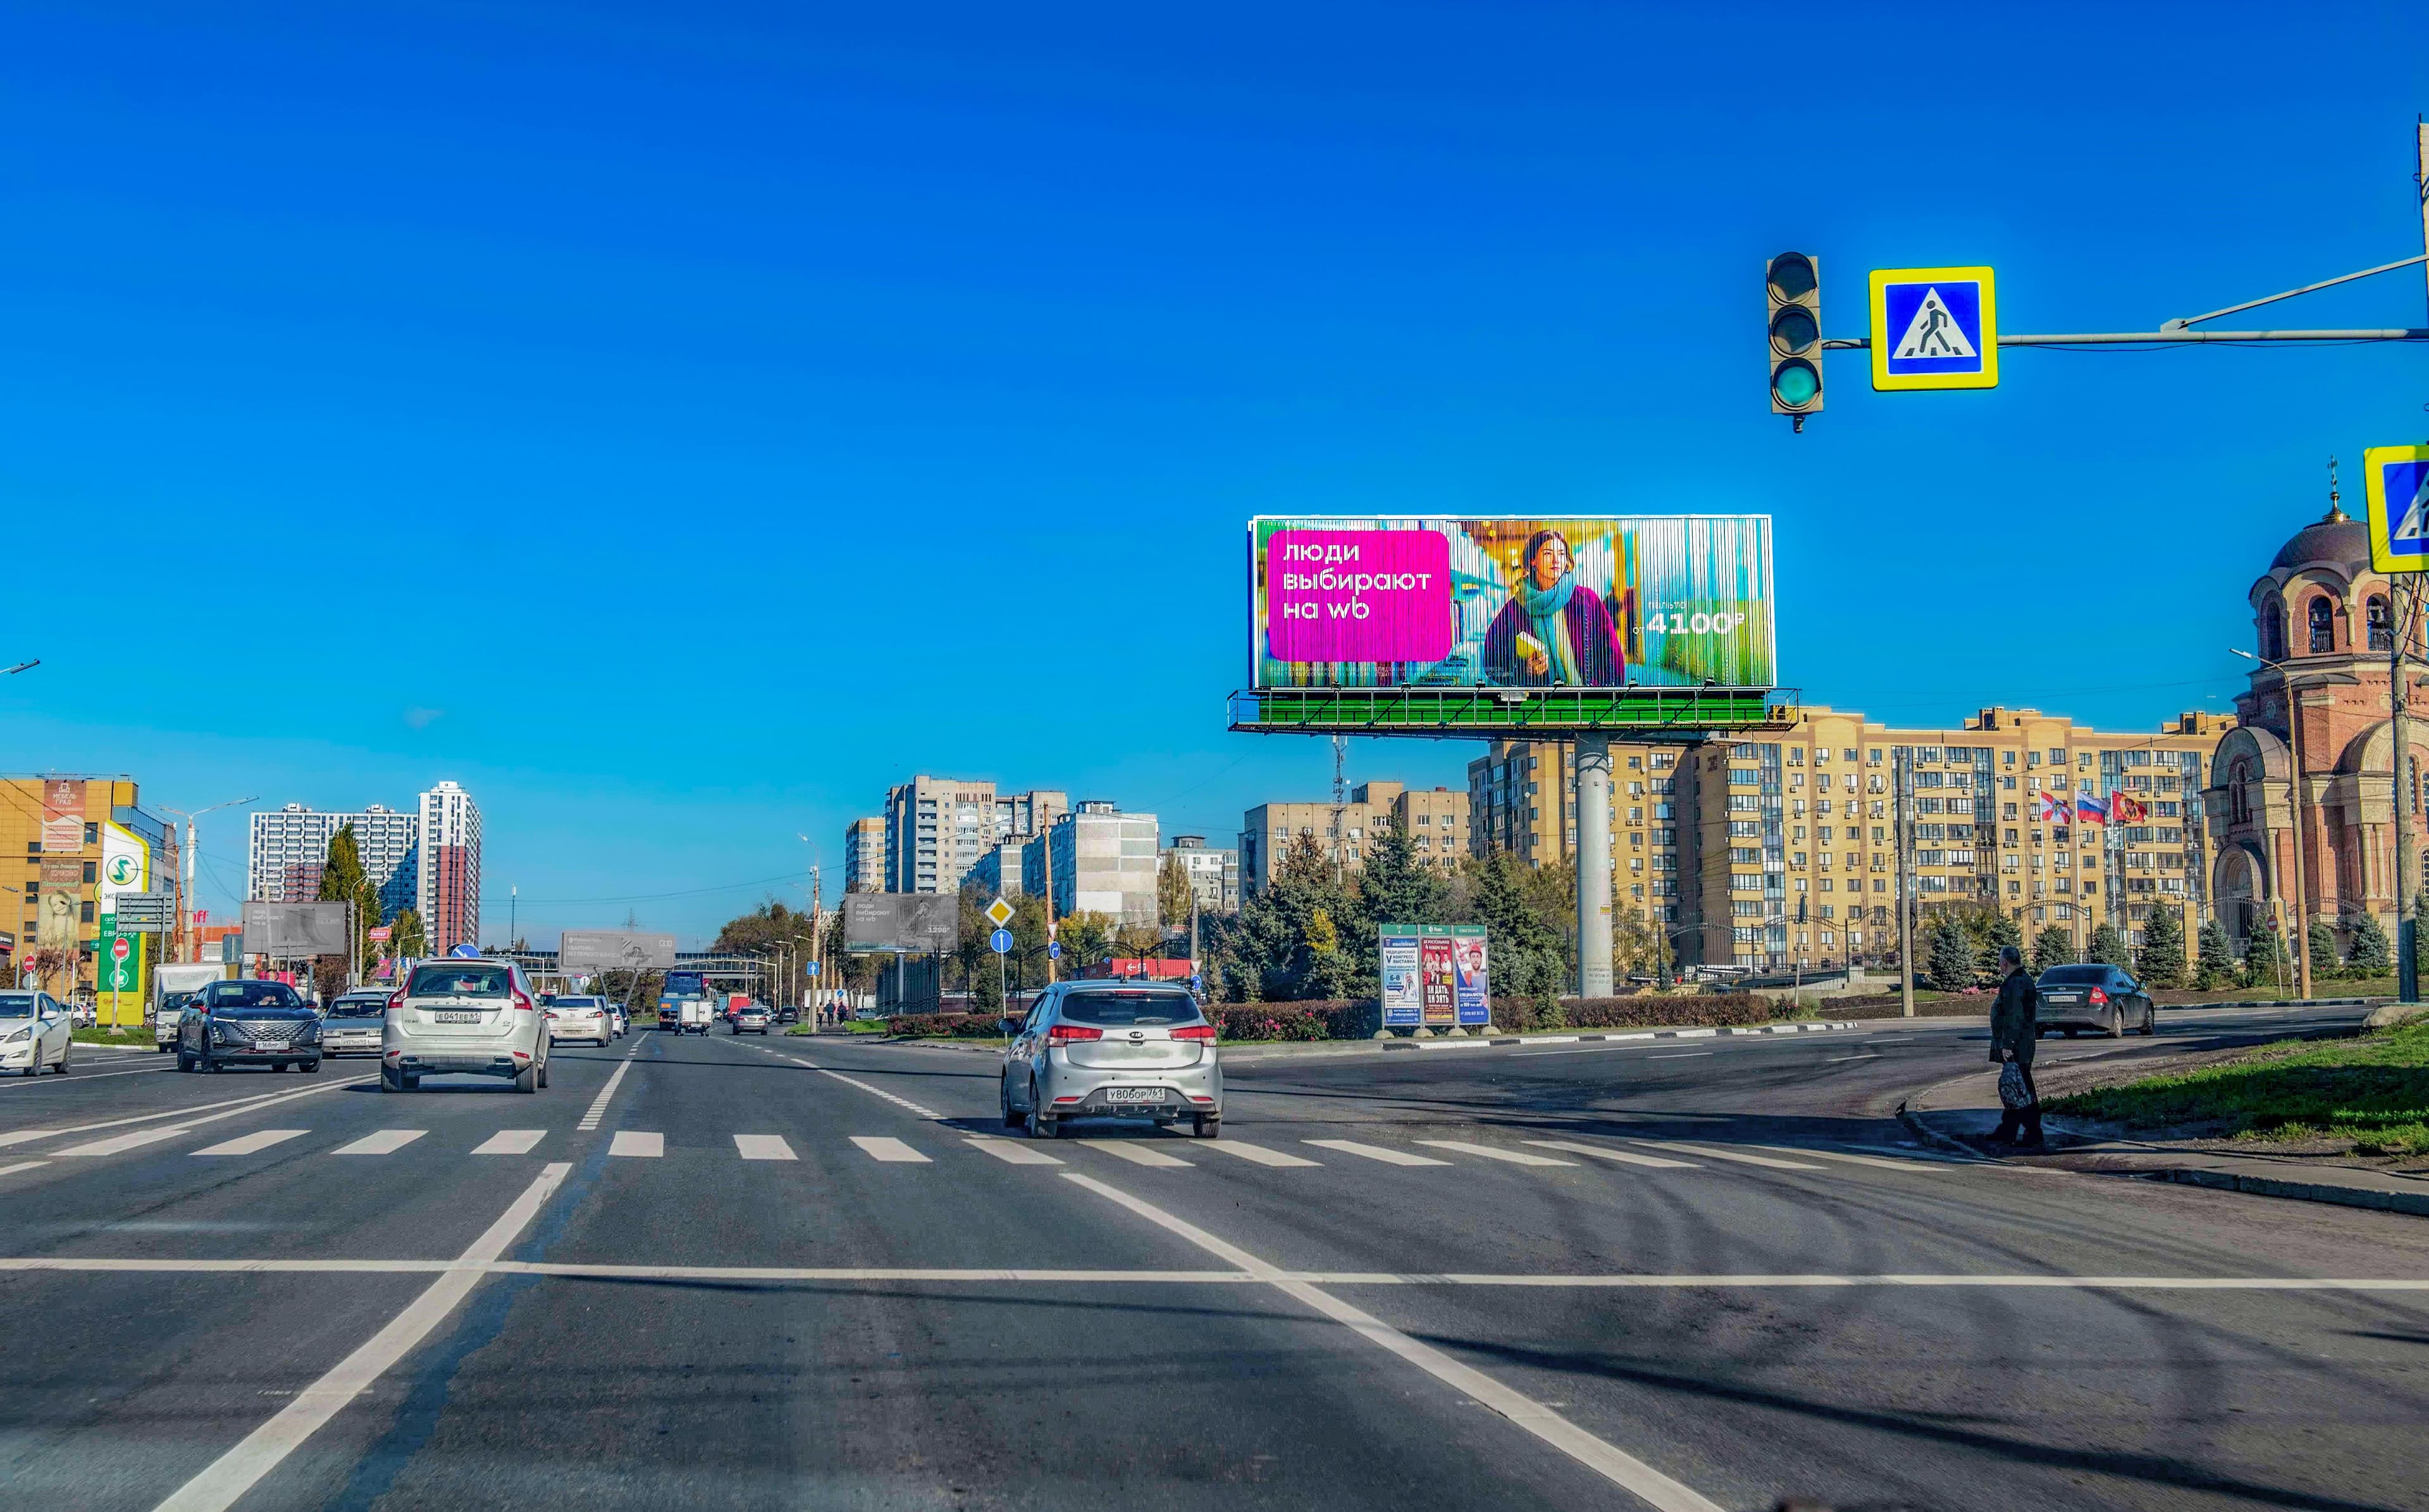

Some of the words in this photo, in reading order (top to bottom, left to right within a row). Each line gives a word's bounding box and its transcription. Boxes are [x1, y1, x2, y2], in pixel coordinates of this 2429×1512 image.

[1283, 544, 1359, 565] люди
[1283, 567, 1431, 596] выбирают
[1283, 602, 1318, 619] на
[1326, 596, 1369, 620] wb
[1427, 985, 1434, 993] НИ
[1428, 994, 1435, 1004] НИ
